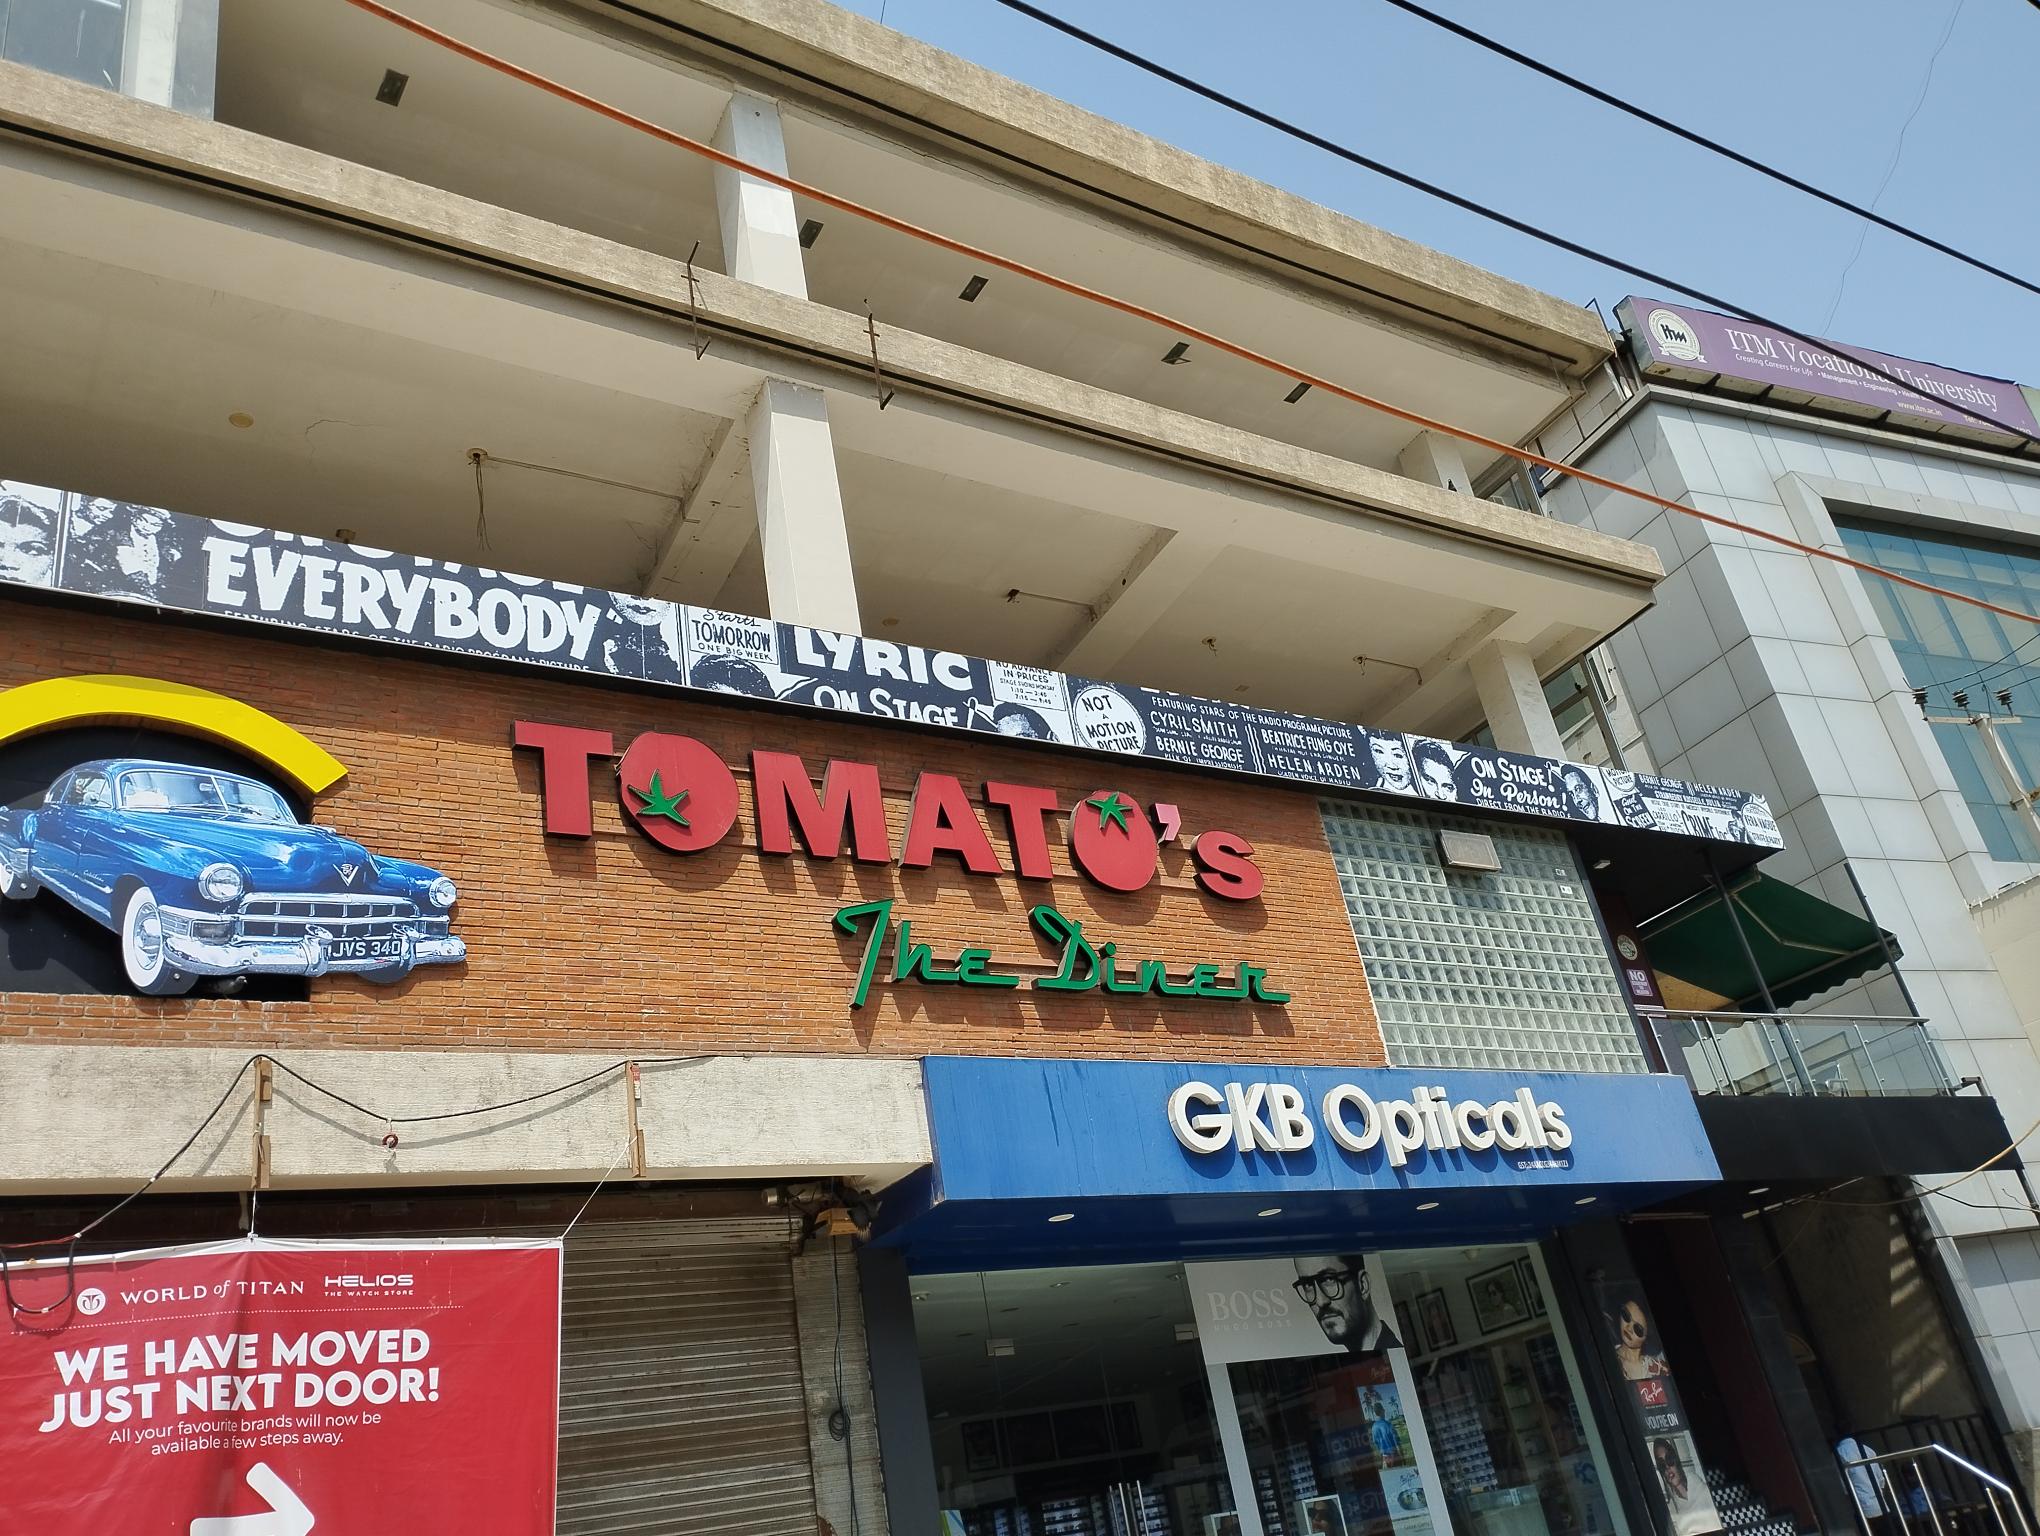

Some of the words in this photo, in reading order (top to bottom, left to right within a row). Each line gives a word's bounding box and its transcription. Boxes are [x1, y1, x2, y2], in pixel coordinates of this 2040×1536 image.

[1725, 328, 1780, 360] ITM
[1894, 367, 1998, 412] University
[1735, 353, 1764, 367] Creating
[1764, 359, 1790, 371] Careers
[1790, 365, 1801, 374] For
[1801, 368, 1814, 377] Life
[202, 536, 602, 661] EVERYBODY
[702, 608, 762, 628] Starts
[691, 619, 772, 653] TOMORROW
[697, 642, 722, 654] ONE
[726, 647, 744, 657] BIG
[745, 650, 774, 662] WEEK
[794, 625, 973, 691] LYRIC
[1003, 669, 1014, 678] IN
[1017, 671, 1049, 684] PRICES
[813, 685, 861, 713] ON
[1081, 694, 1113, 712] NOT
[1085, 721, 1137, 740] MOTION
[1150, 710, 1192, 732] CYRIL
[1191, 715, 1239, 739] SMITH
[1151, 696, 1197, 713] FEATURING
[1199, 705, 1225, 718] STARS
[1228, 710, 1240, 720] OF
[1241, 711, 1258, 723] THE
[1257, 714, 1281, 727] RADIO
[1322, 725, 1353, 740] PICTURE
[1096, 735, 1141, 752] PICTURE
[1155, 735, 1198, 757] BERNIE
[1200, 743, 1245, 764] GEORGE
[1260, 728, 1307, 750] BEATRICE
[1306, 735, 1333, 753] FUNG
[1333, 740, 1356, 758] OYE
[1267, 753, 1313, 774] HELEN
[1316, 760, 1361, 781] ARDEN
[1470, 756, 1497, 781] ON
[1470, 778, 1496, 800] In
[1499, 782, 1569, 812] Person!
[1693, 782, 1718, 795] HELEN
[1718, 786, 1742, 799] ARDEN
[511, 719, 1266, 902] TOMATO'S
[1476, 797, 1502, 809] DIRECT
[1503, 802, 1526, 813] FROM
[1525, 805, 1540, 815] THE
[1540, 808, 1566, 818] RADIO
[370, 940, 401, 957] 340
[831, 897, 1020, 1010] The
[1028, 904, 1292, 1005] Diner
[1629, 969, 1646, 982] NO
[1168, 1081, 1315, 1154] GKB
[1322, 1083, 1572, 1168] Opticals
[119, 1284, 208, 1306] WORLD
[212, 1279, 231, 1297] of
[236, 1280, 304, 1296] TITAN
[324, 1273, 414, 1288] HELIOS
[1207, 1287, 1289, 1322] BOSS
[54, 1344, 128, 1387] WE
[145, 1333, 258, 1377] HAVE
[272, 1328, 430, 1367] MOVED
[38, 1381, 161, 1434] JUST
[175, 1372, 282, 1415] NEXT
[294, 1366, 440, 1408] DOOR!
[108, 1427, 131, 1445] All
[134, 1425, 174, 1444] your
[177, 1418, 238, 1436] favourite
[240, 1413, 293, 1433] brands
[295, 1413, 321, 1428] will
[325, 1414, 359, 1428] now
[362, 1410, 382, 1425] be
[151, 1434, 221, 1456] available
[223, 1438, 229, 1449] a
[231, 1435, 257, 1449] few
[259, 1431, 300, 1447] steps
[302, 1432, 344, 1446] away.
